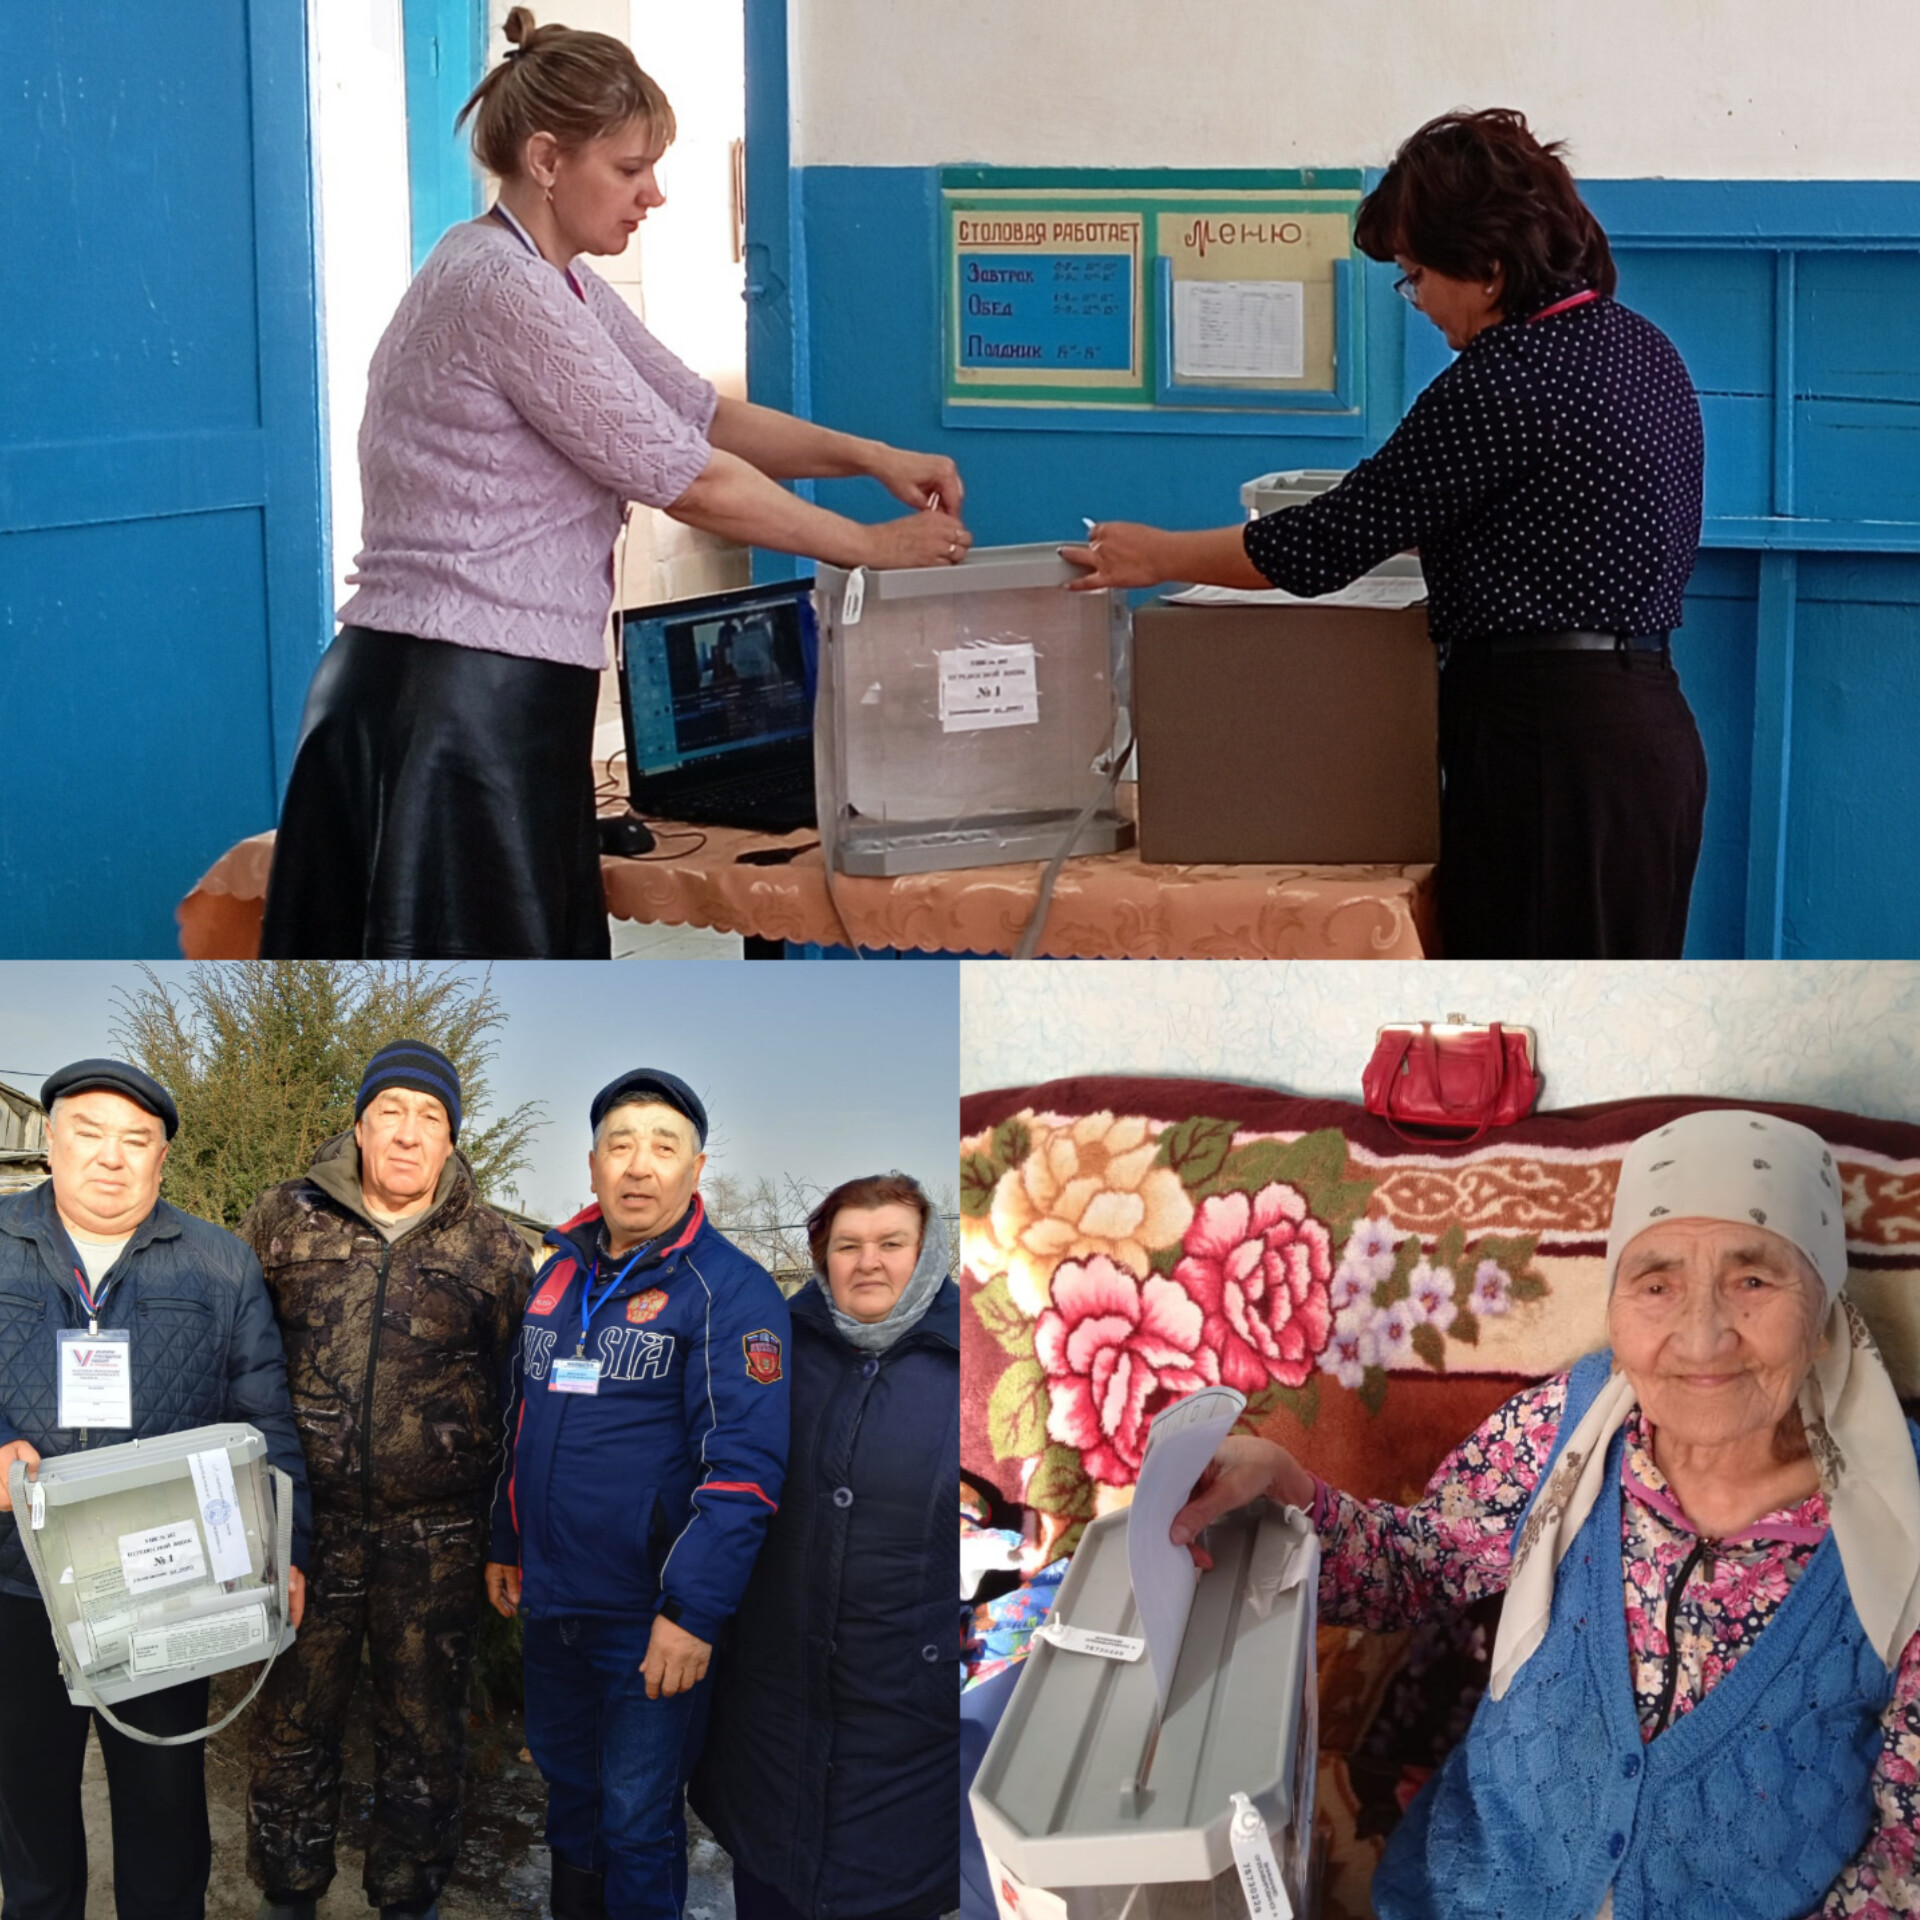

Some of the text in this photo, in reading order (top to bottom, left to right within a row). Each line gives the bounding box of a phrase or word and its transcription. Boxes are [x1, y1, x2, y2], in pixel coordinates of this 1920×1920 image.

[958, 221, 1140, 244] СТОЛОВАЯ РАБОТАЕТ
[153, 1555, 167, 1567] №
